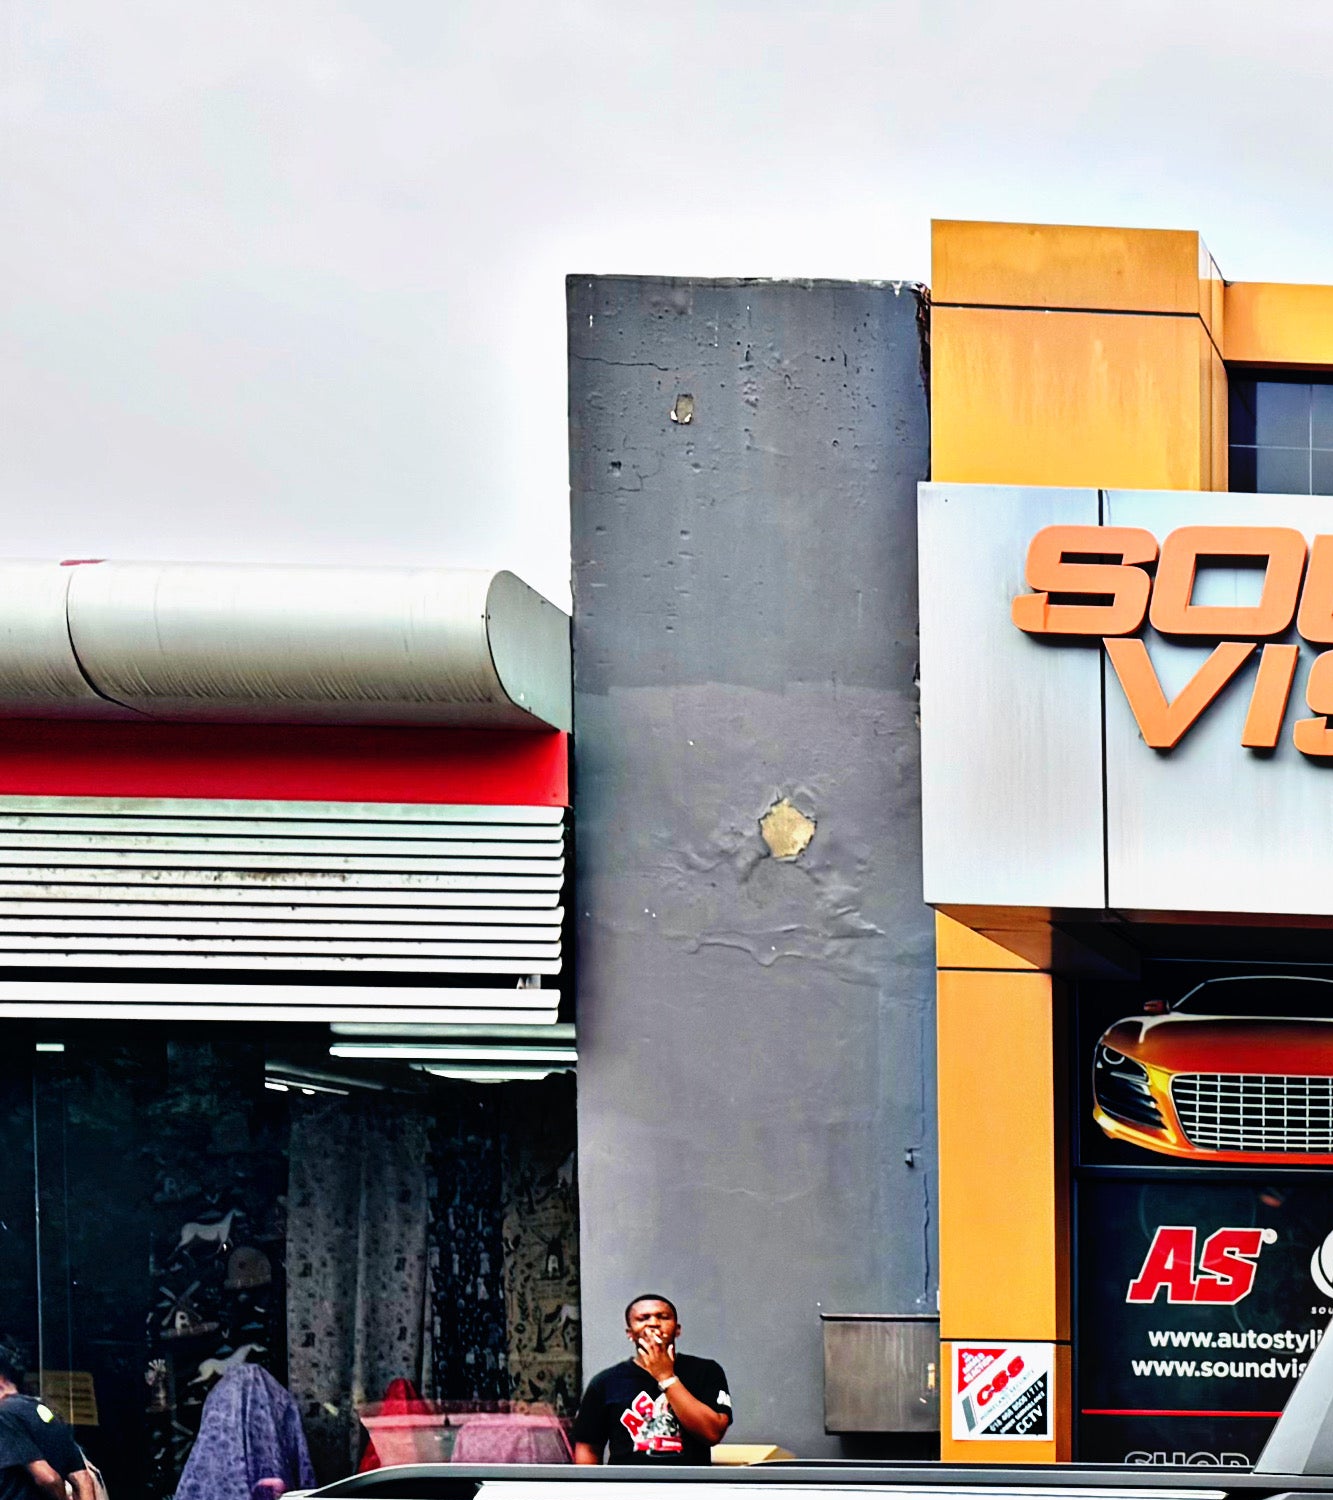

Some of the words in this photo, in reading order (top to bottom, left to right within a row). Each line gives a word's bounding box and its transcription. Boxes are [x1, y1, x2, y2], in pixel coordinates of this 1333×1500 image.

[1148, 1330, 1323, 1353] www.autostyli
[1131, 1358, 1308, 1378] www.soundvis
[1015, 1404, 1044, 1434] CCTV
